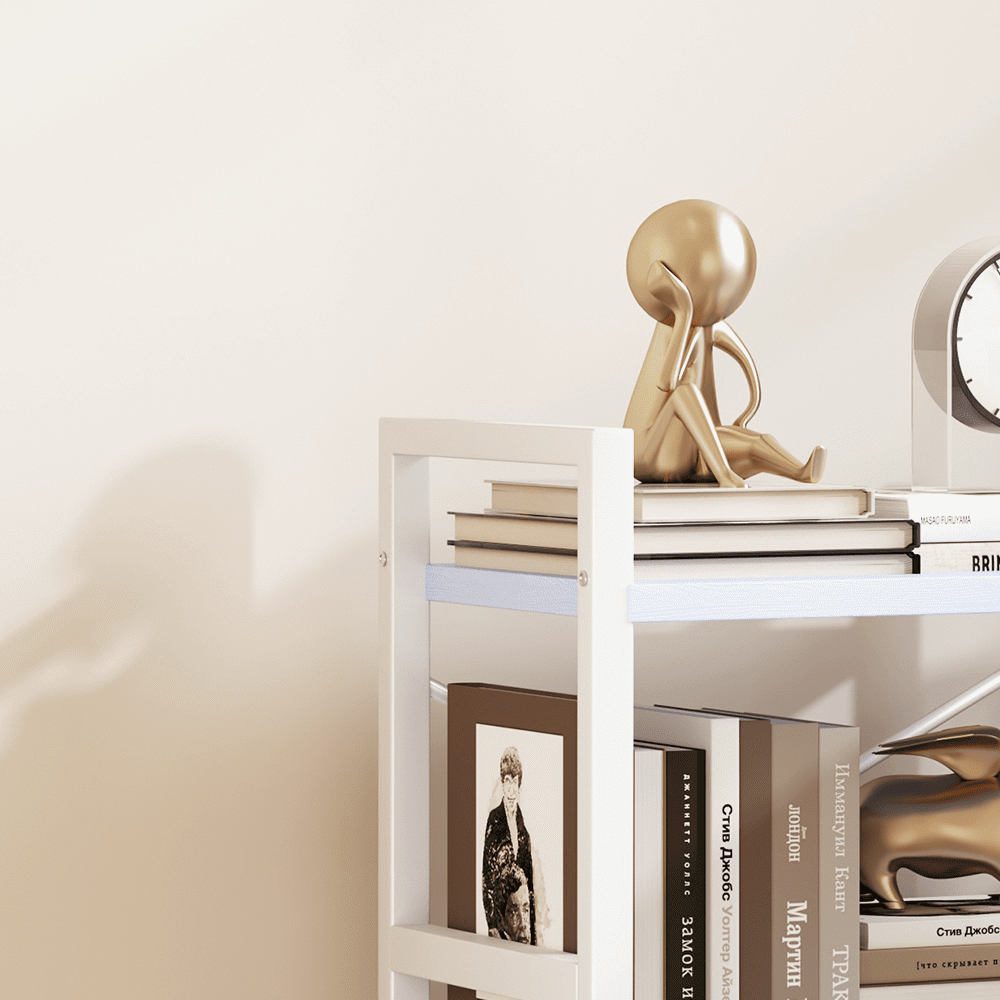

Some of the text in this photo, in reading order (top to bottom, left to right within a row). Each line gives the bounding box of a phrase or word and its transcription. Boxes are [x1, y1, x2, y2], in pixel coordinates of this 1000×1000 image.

[722, 804, 733, 843] Стив
[832, 763, 850, 912] Иммануил Кант
[720, 847, 733, 901] Джобс
[720, 905, 733, 962] Уолтер
[782, 901, 807, 988] Мартин
[936, 927, 962, 937] Стив
[964, 925, 1000, 937] Джобс
[942, 959, 989, 969] скрывает
